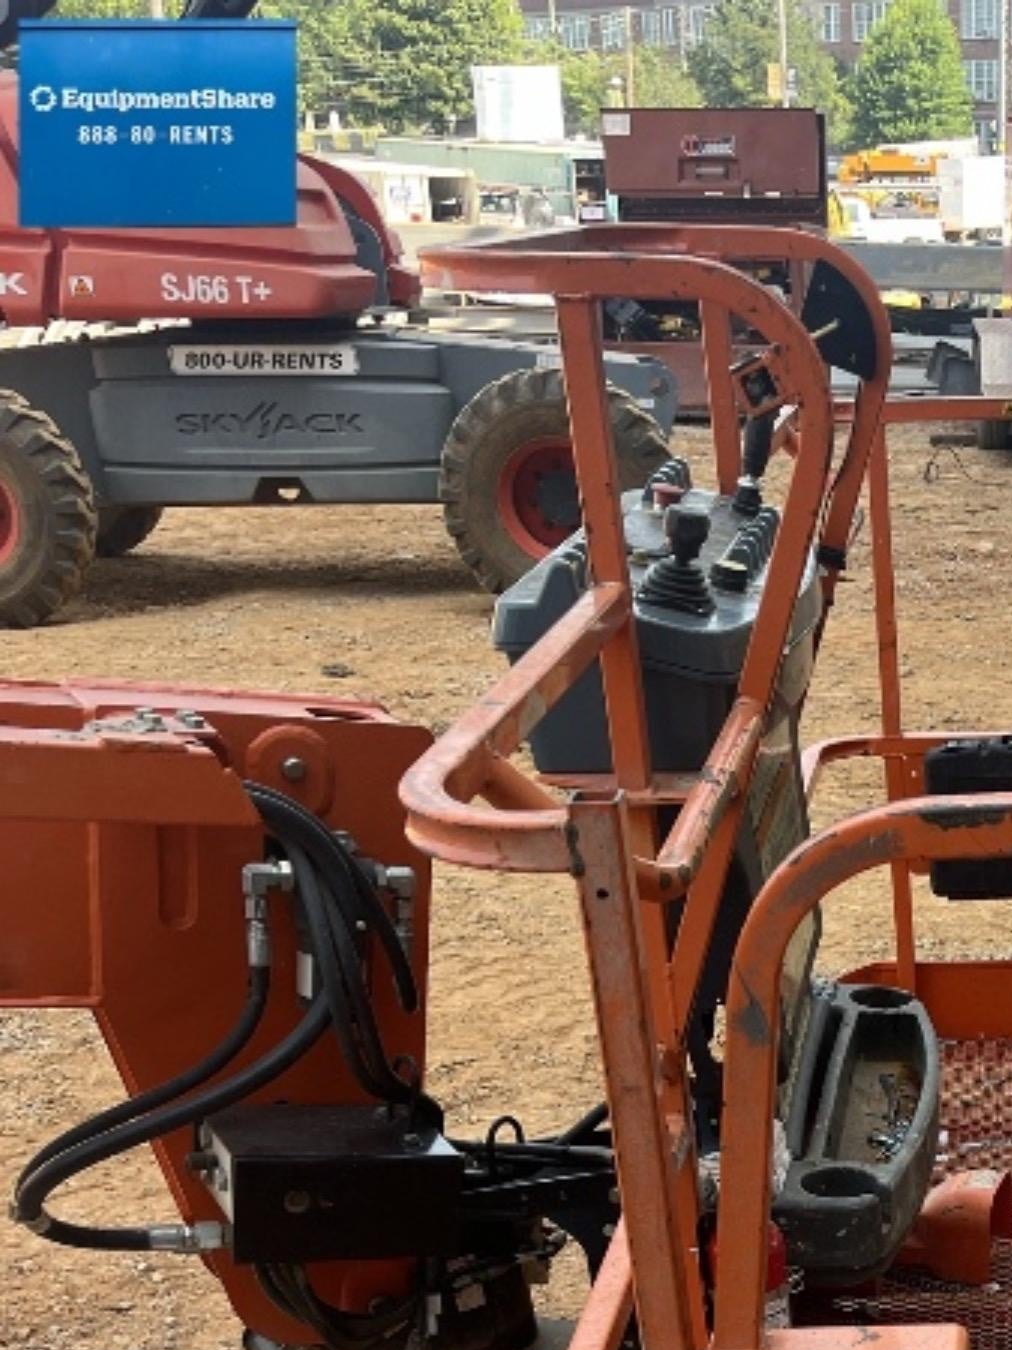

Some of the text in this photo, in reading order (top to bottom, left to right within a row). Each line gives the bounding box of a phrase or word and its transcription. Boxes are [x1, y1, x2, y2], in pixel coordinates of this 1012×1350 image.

[160, 272, 272, 304] SJ66 T+
[185, 352, 343, 370] 800-UR-RENTS
[175, 401, 364, 439] SKYJACK
